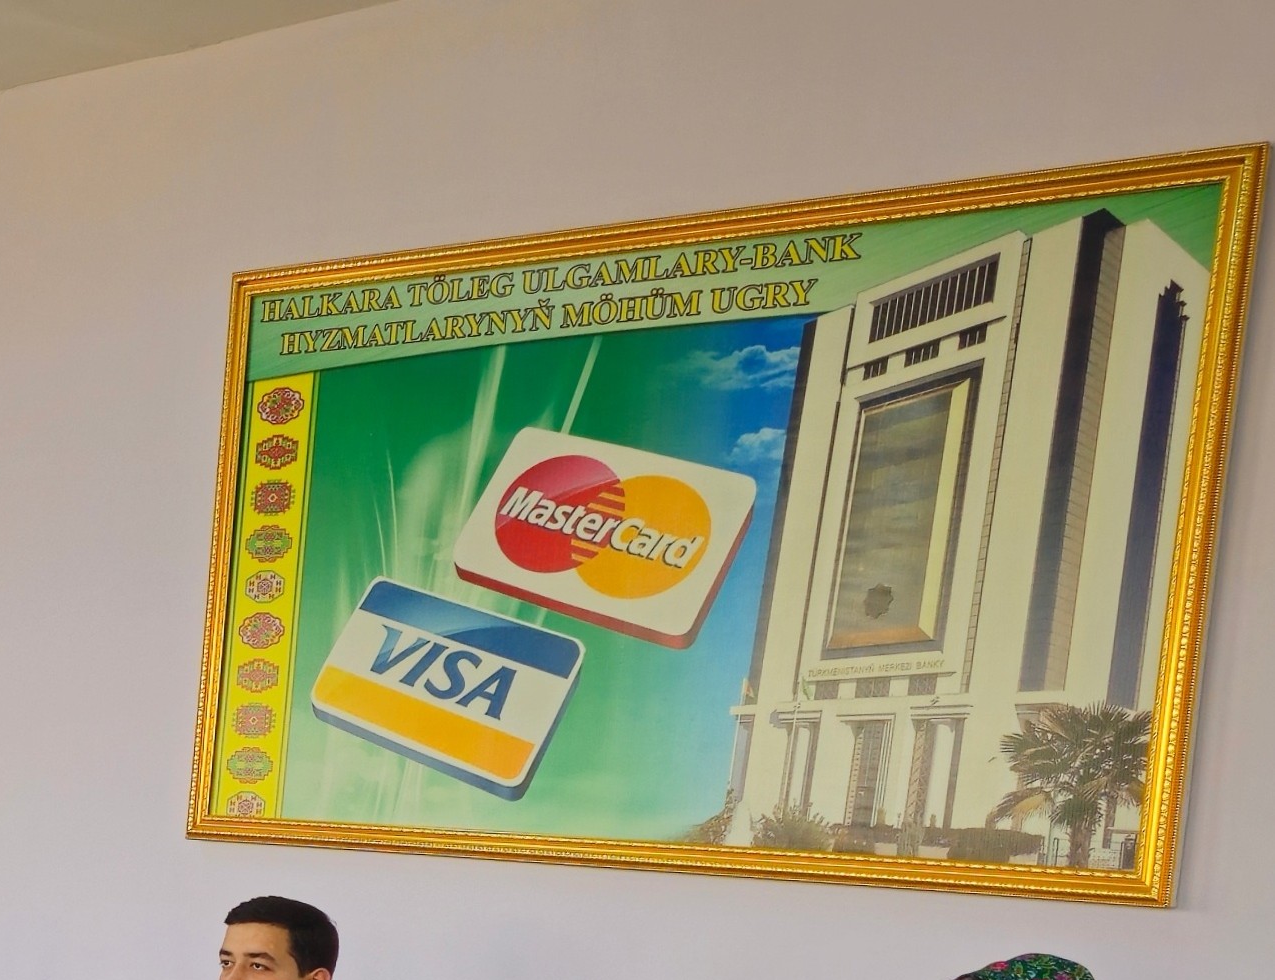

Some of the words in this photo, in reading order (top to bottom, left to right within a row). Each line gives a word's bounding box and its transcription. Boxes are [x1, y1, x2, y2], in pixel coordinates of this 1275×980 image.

[260, 286, 402, 322] HALKARA
[408, 274, 514, 308] TÖLEG
[522, 232, 863, 294] ULGAMLARY-BANK
[280, 299, 555, 356] HYZMATLARYNYŇ
[560, 288, 703, 329] MÖHÜM
[710, 278, 818, 314] UGRY
[499, 486, 704, 569] MasterCard
[369, 624, 517, 720] VISA
